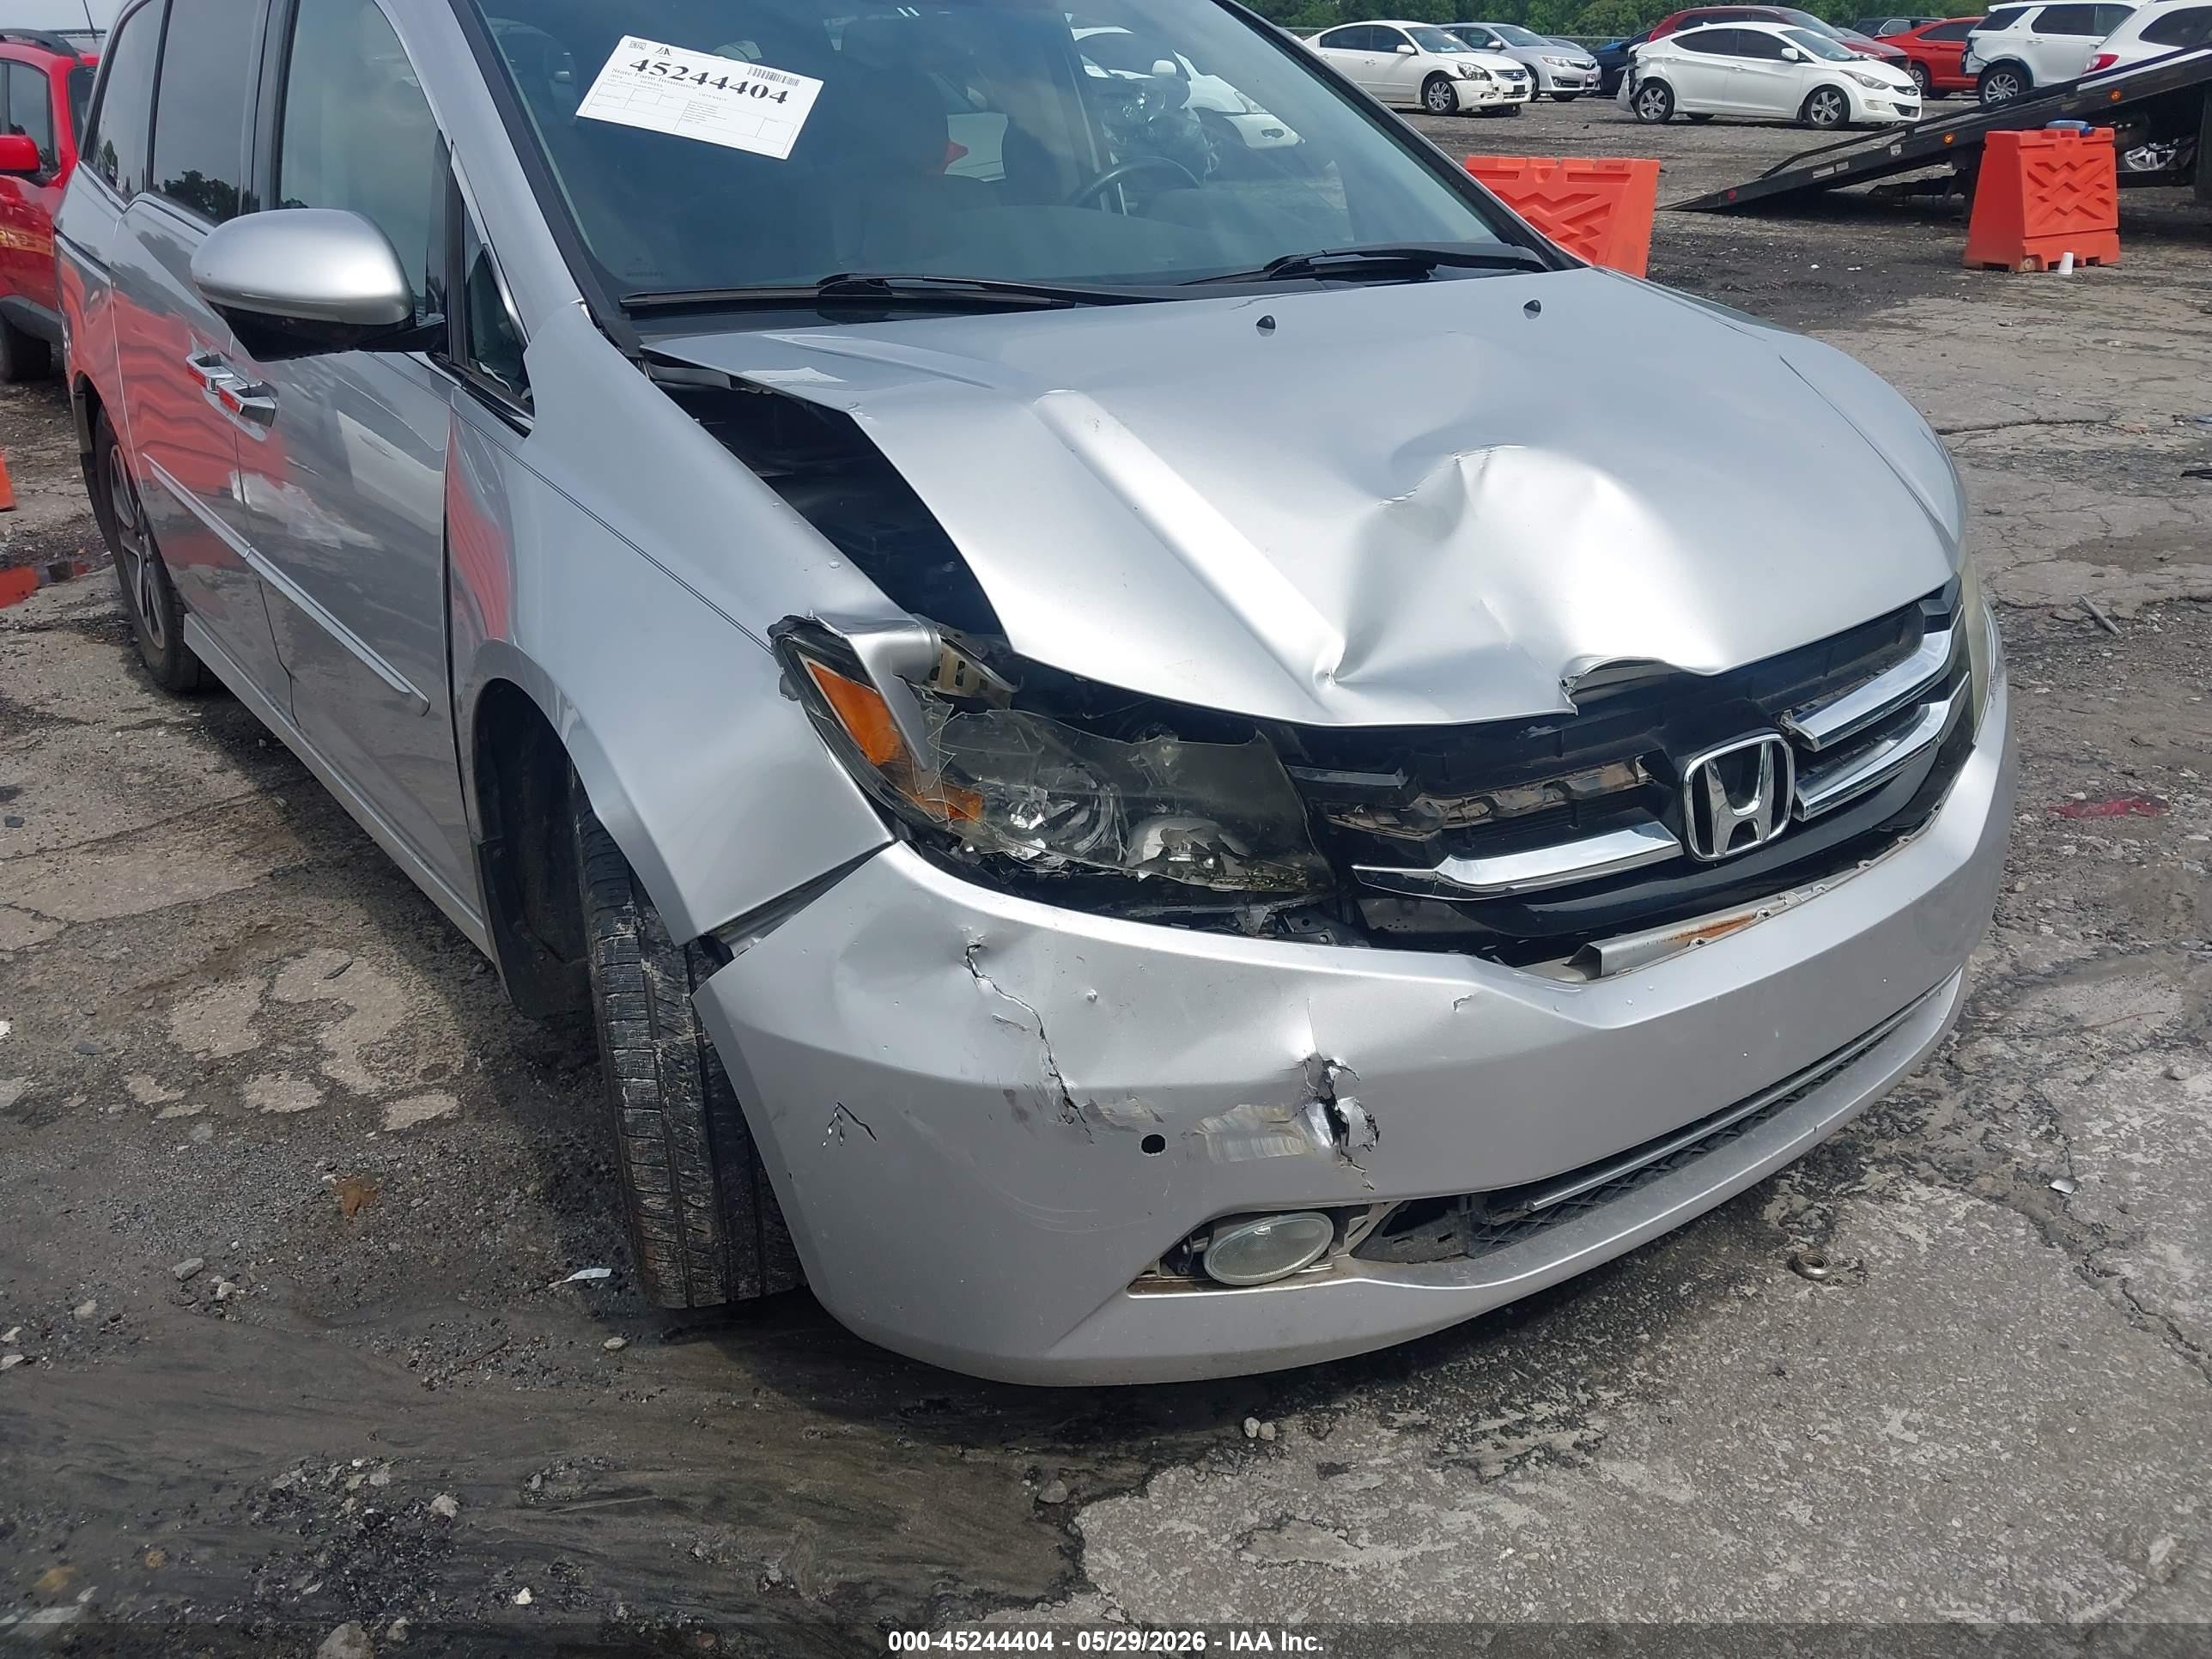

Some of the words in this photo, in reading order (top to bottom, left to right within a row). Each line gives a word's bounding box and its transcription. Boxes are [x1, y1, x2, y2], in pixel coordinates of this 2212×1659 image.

[611, 68, 633, 76] State
[634, 72, 656, 82] Farm
[658, 76, 697, 90] Insurance
[629, 58, 788, 104] 45244404
